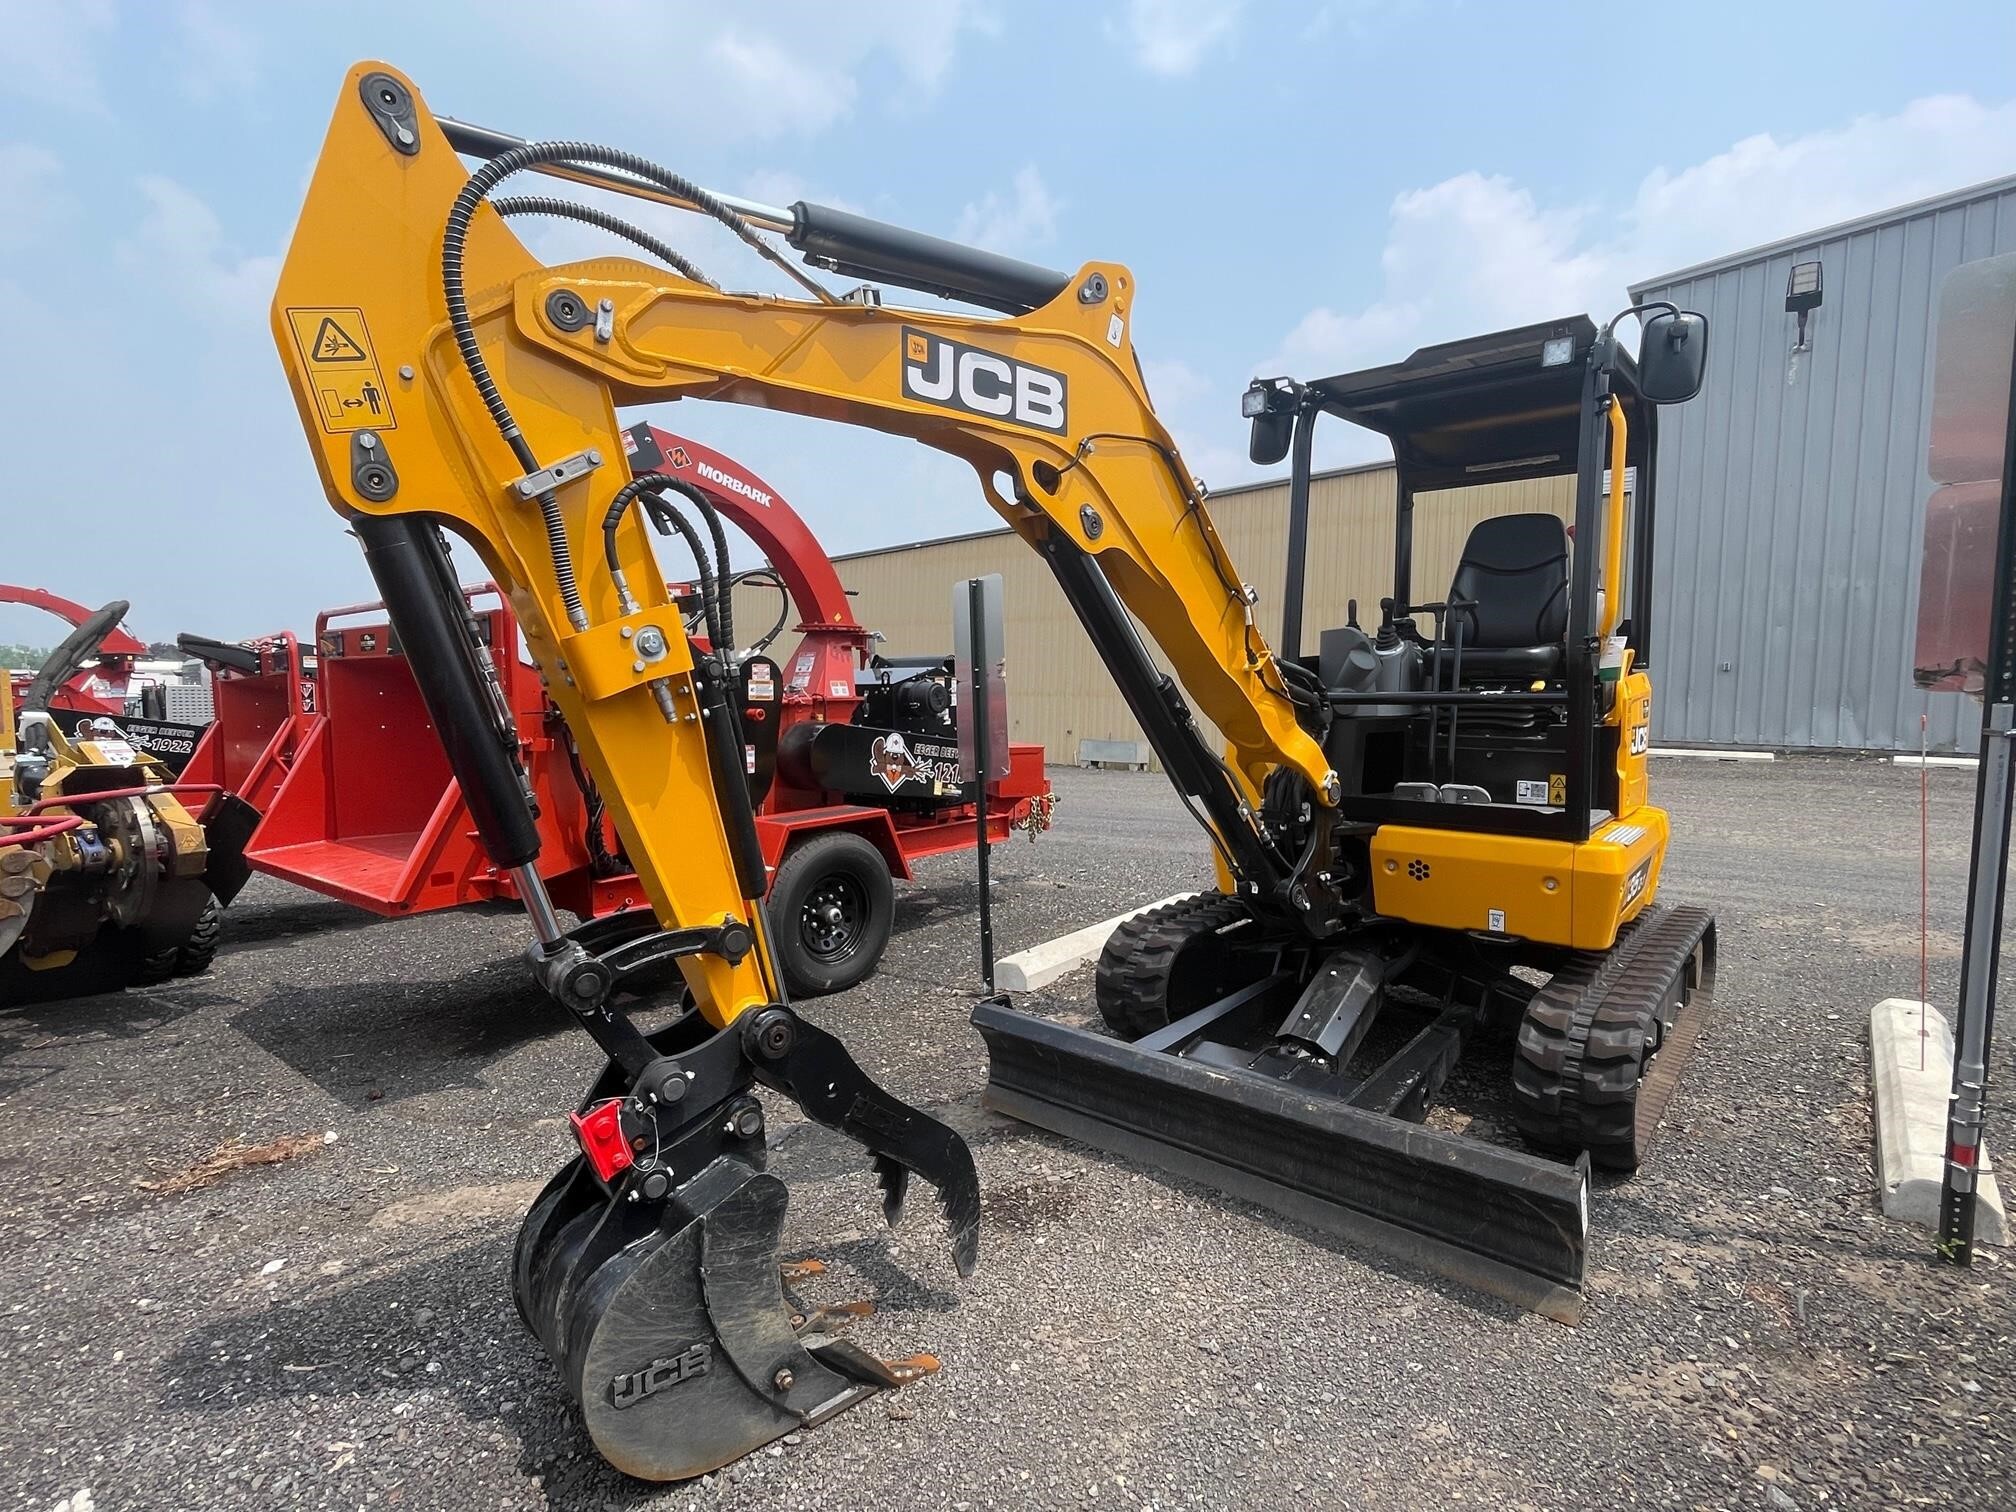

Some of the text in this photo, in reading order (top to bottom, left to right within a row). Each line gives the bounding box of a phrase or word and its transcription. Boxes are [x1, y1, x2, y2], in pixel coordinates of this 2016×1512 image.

[907, 342, 1065, 429] JCB
[697, 461, 773, 509] MORBARK
[152, 738, 193, 754] 1922
[914, 743, 940, 757] EEGER
[614, 1343, 713, 1409] JCB
